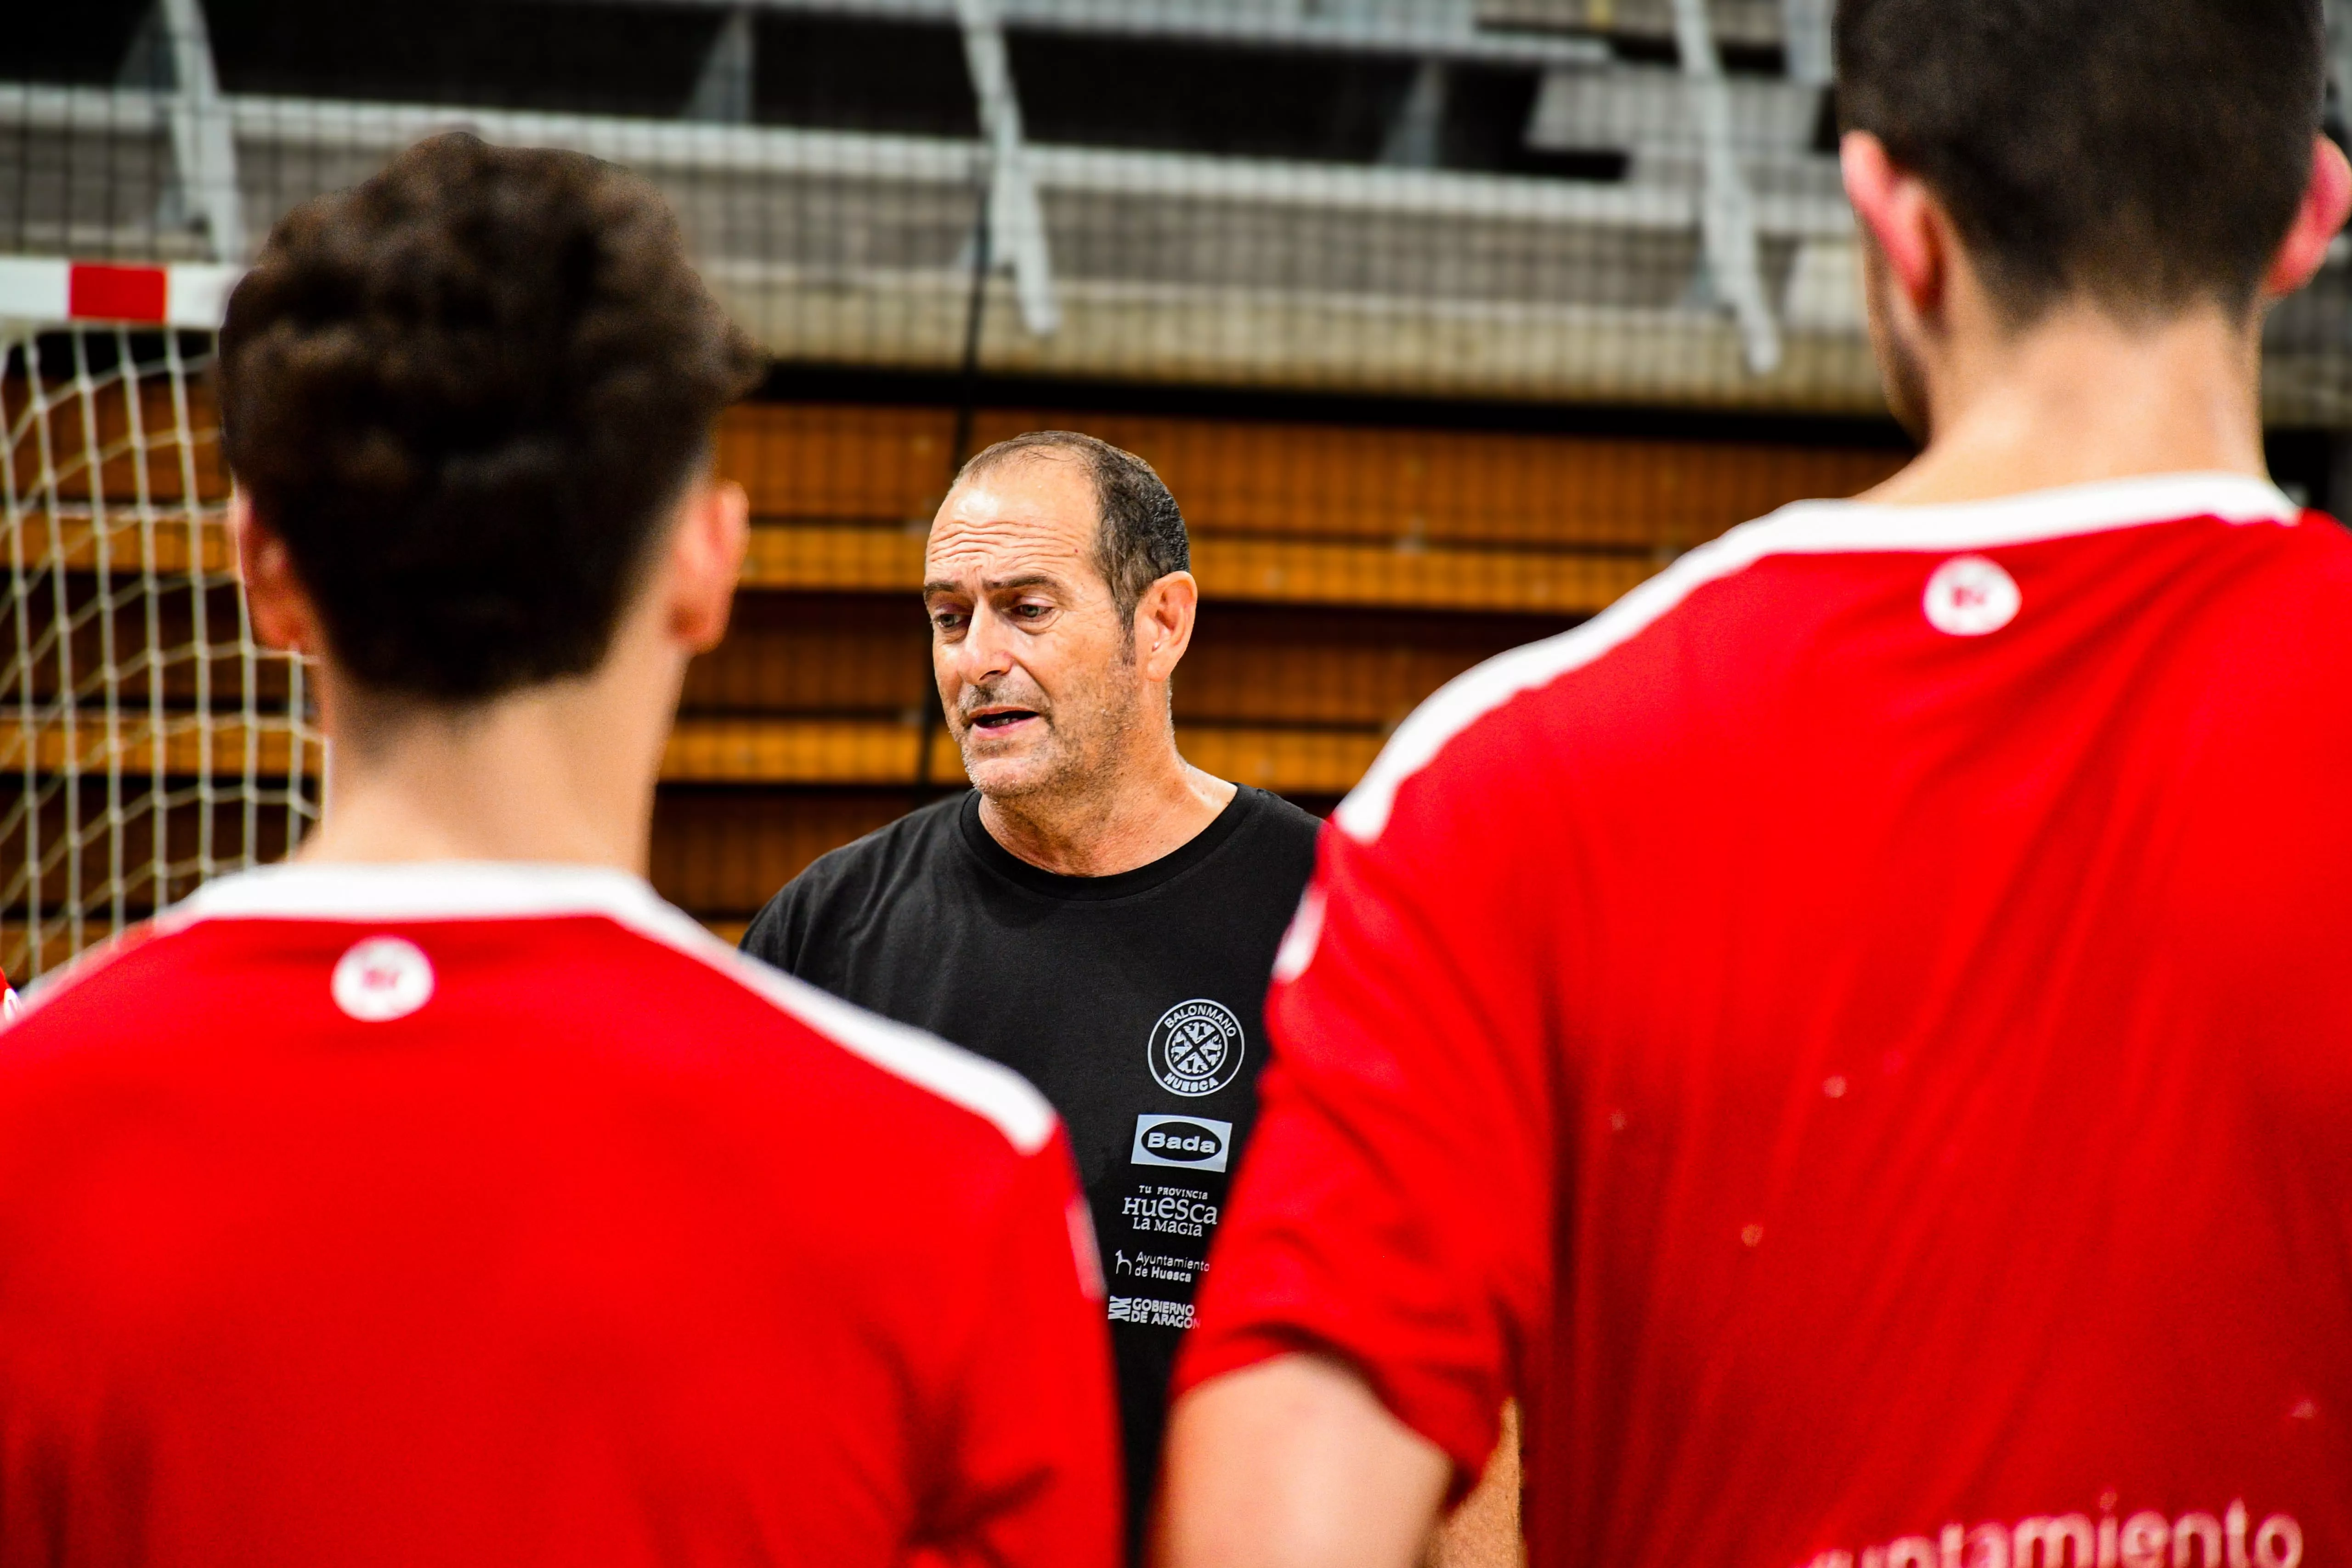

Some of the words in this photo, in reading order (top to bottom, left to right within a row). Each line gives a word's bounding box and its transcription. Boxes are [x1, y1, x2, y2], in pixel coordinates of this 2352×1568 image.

[1164, 1005, 1237, 1037] BALONMANO
[1164, 1072, 1219, 1092] HUESCA
[1148, 1132, 1216, 1154] Bada
[1136, 1251, 1210, 1272] Ayuntamiento
[1135, 1265, 1148, 1277] de
[1151, 1266, 1192, 1283] Huesca
[1131, 1310, 1148, 1323] DE
[1132, 1297, 1195, 1317] GOBIERNO
